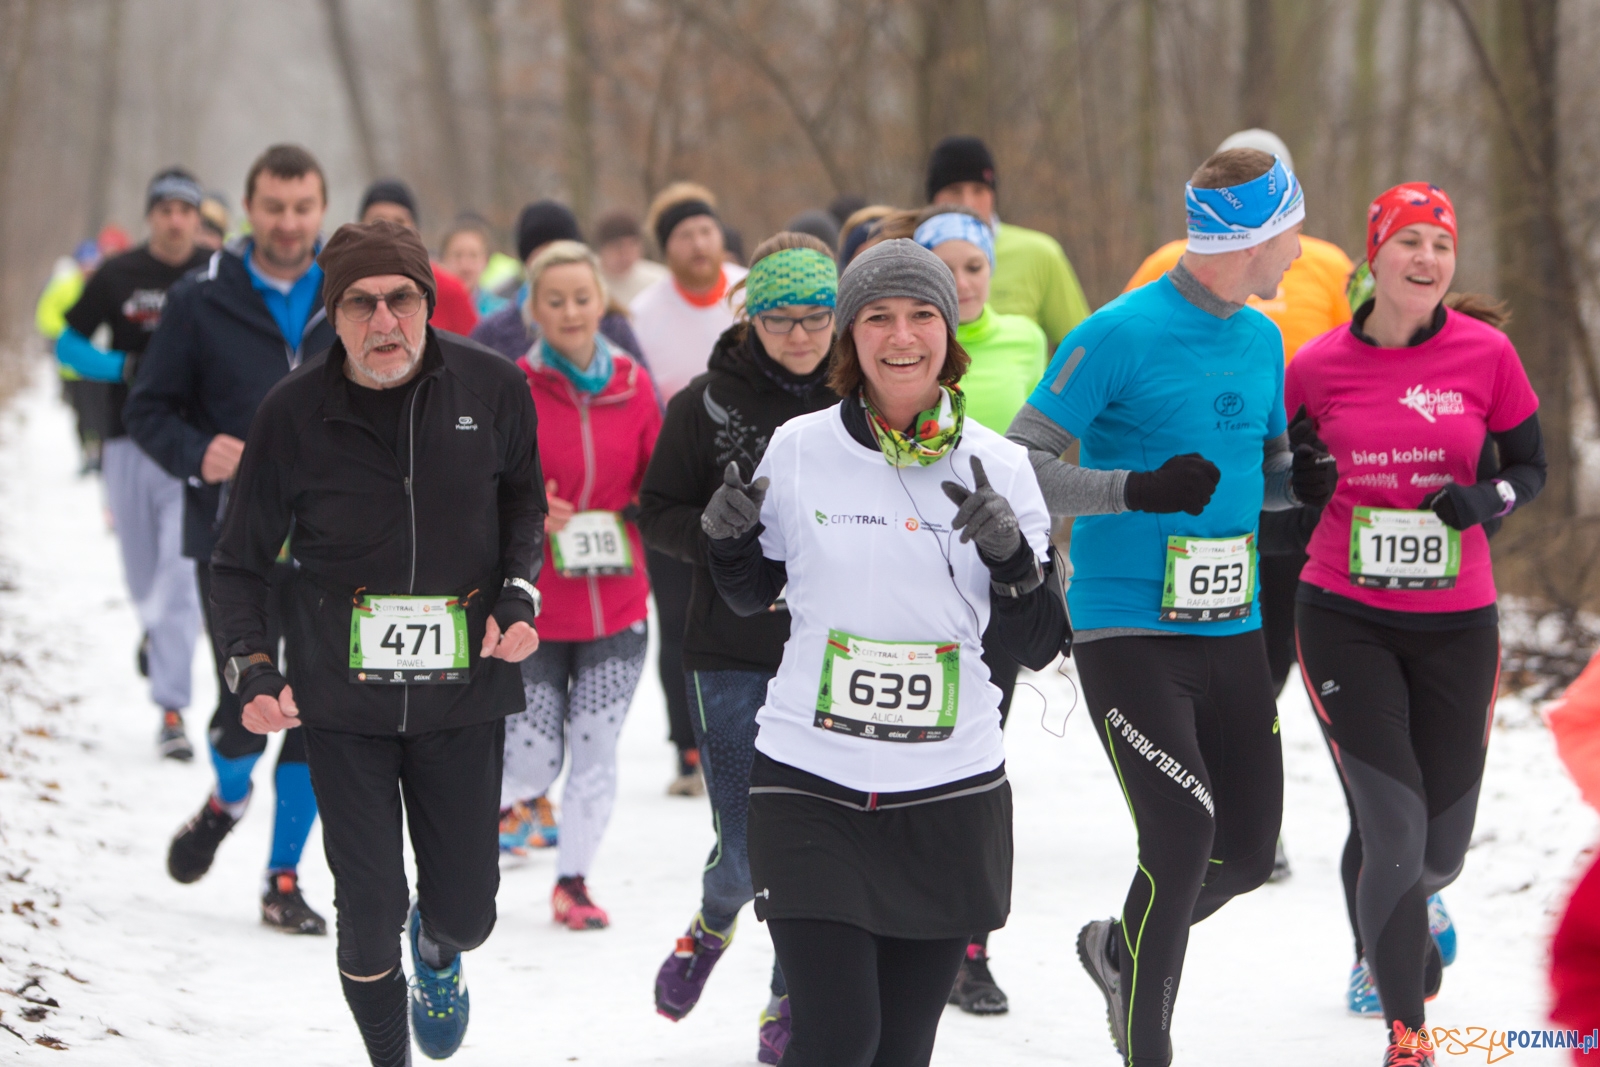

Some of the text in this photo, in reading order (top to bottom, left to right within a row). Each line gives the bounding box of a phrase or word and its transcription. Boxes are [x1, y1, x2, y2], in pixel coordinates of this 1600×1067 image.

[1351, 449, 1389, 466] bieg
[1391, 446, 1446, 464] kobiet
[573, 531, 616, 556] 318
[1371, 534, 1442, 564] 1198
[1190, 562, 1243, 595] 653
[380, 624, 441, 656] 471
[396, 659, 426, 668] PAWEŁ
[849, 669, 932, 711] 639
[945, 683, 955, 717] Poznań
[871, 712, 904, 723] ALICJA
[1105, 707, 1215, 818] WWW.STEELPRESS.EU
